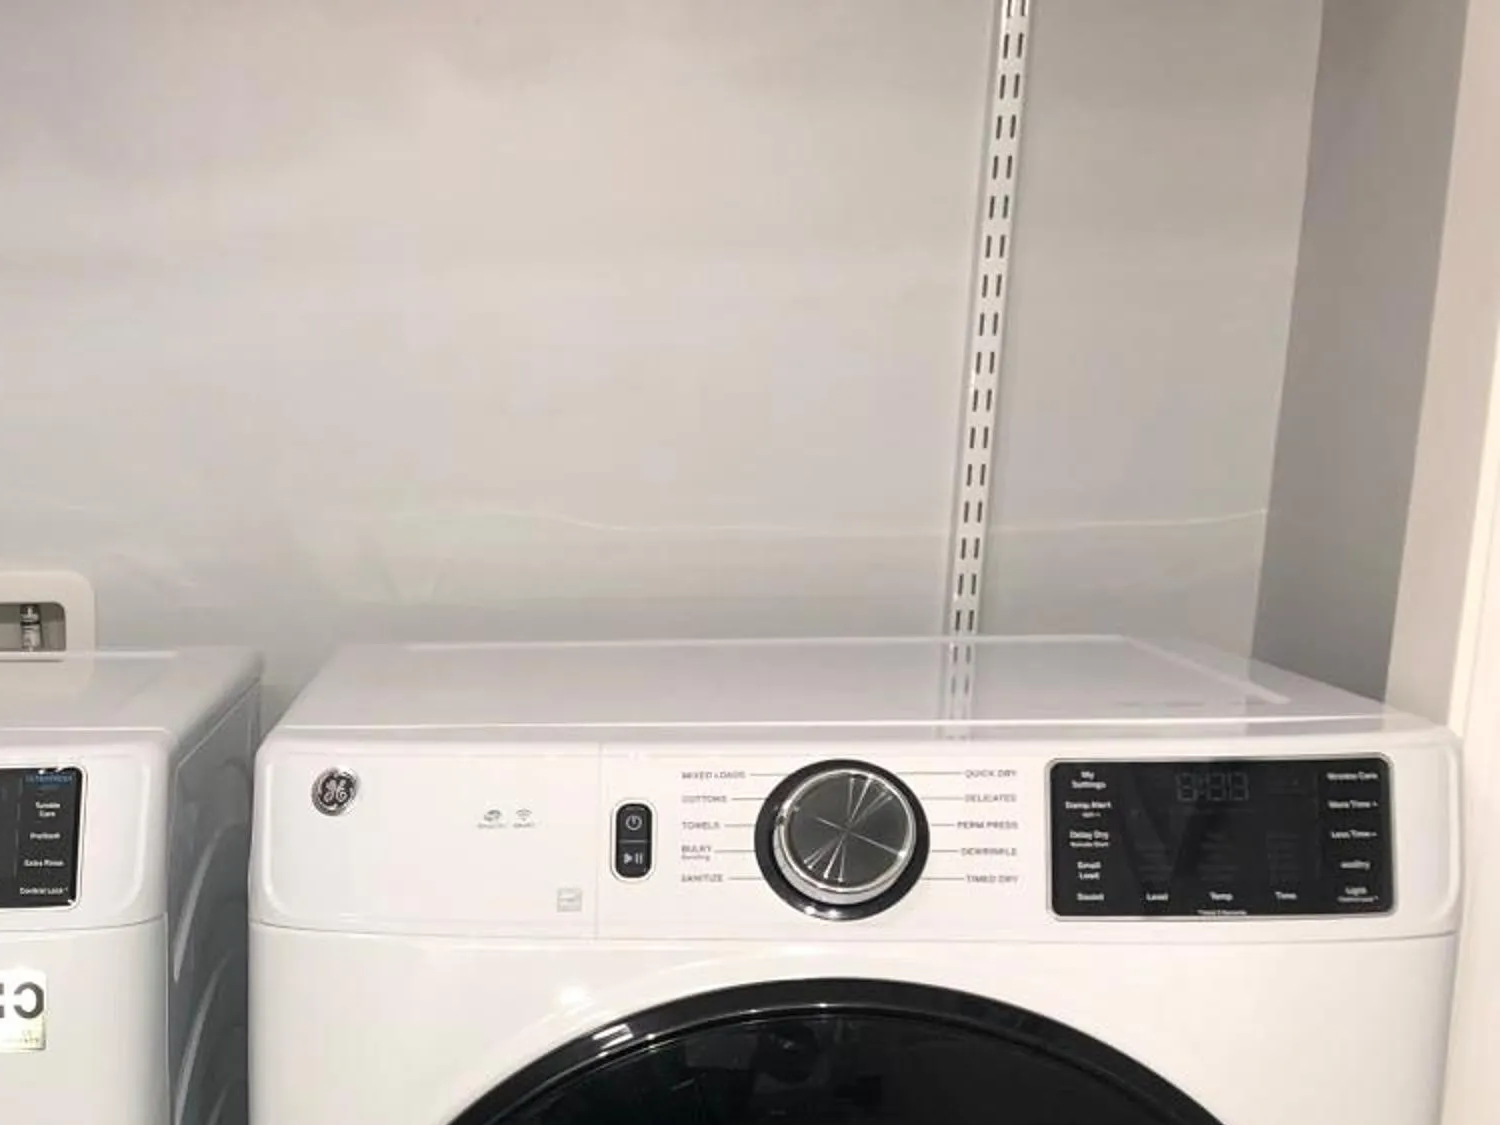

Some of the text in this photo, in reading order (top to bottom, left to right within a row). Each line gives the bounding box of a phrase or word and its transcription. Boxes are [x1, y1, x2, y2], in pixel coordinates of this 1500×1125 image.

[682, 771, 746, 779] MIXED LOADS
[964, 769, 1017, 778] QUICK DRY
[964, 794, 1017, 802] DELICATES
[682, 821, 721, 829] TOWELS
[957, 821, 1018, 829] PERM PRESS
[1069, 830, 1110, 840] Delay Dry
[681, 845, 711, 853] BULKY
[966, 875, 1019, 883] TIMED DRY
